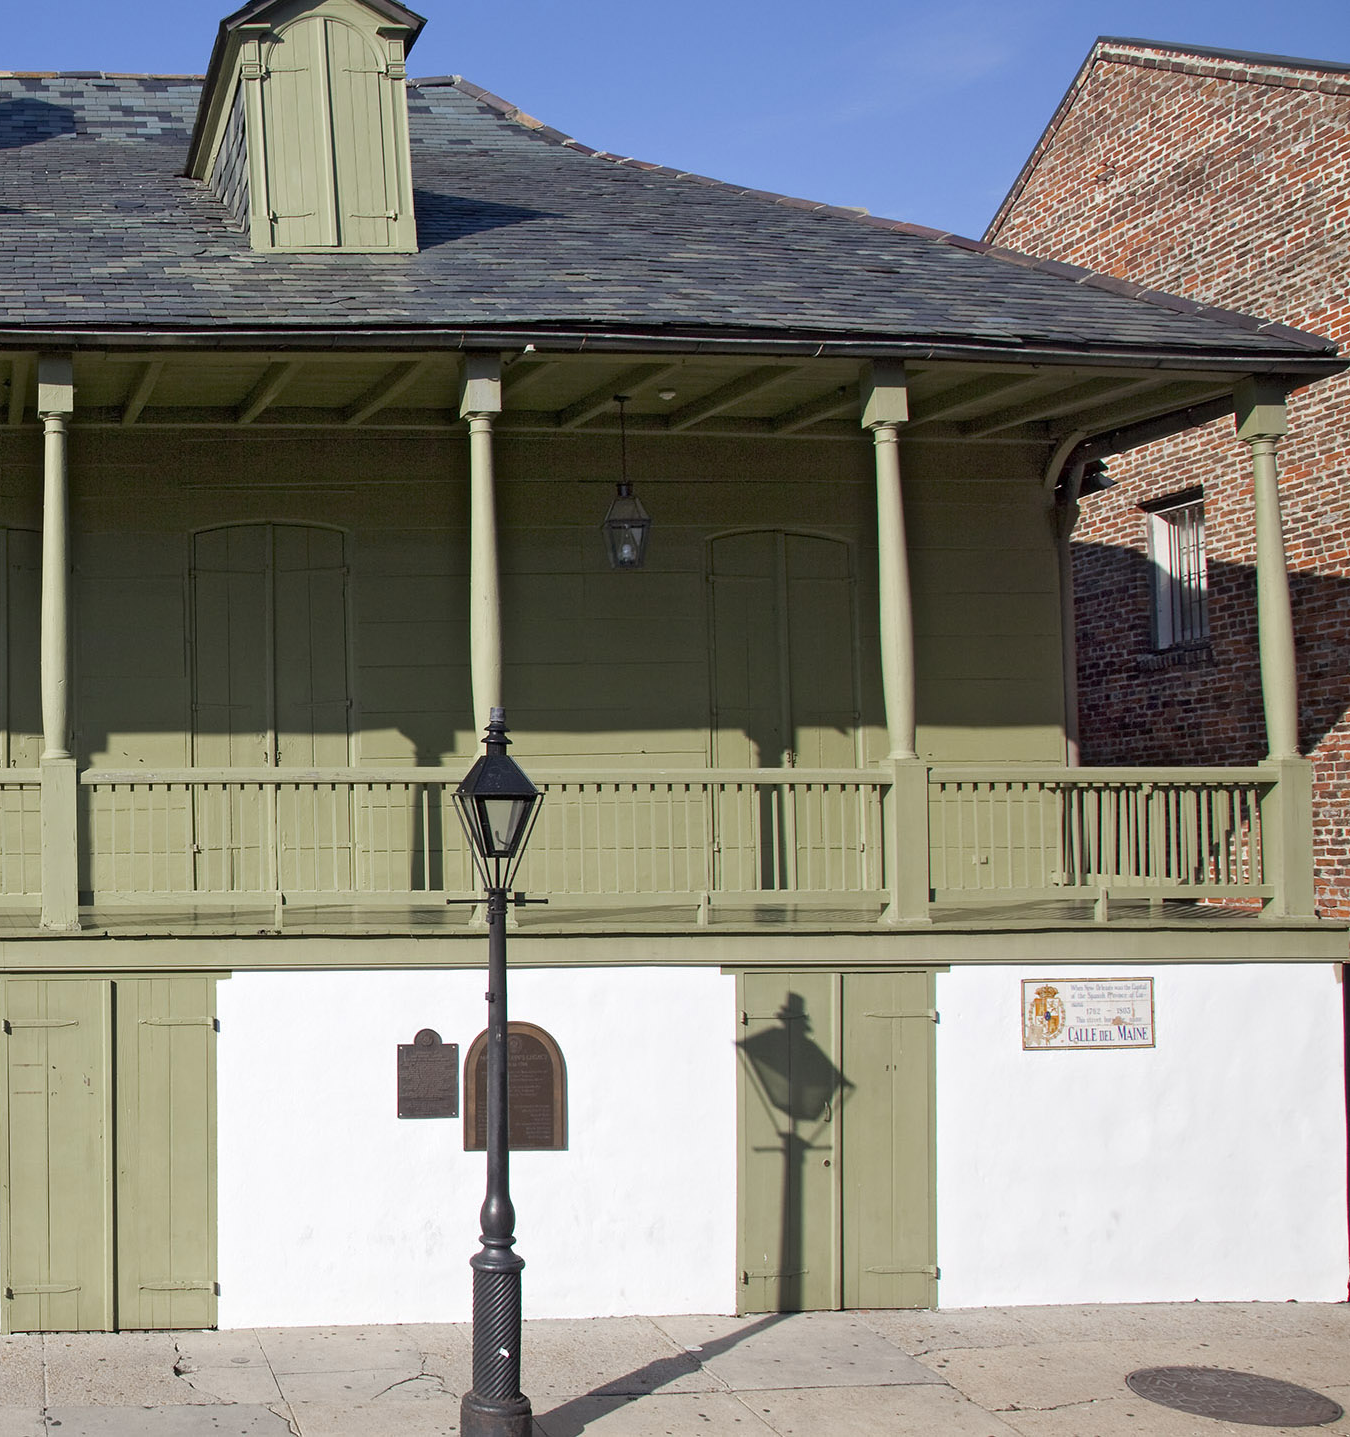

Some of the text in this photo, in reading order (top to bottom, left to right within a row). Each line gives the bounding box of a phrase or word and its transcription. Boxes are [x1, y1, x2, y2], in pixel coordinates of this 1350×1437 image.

[1131, 983, 1147, 991] Capital
[1087, 991, 1106, 1000] Spanish
[1068, 1025, 1148, 1042] CALLE DEL MAINE
